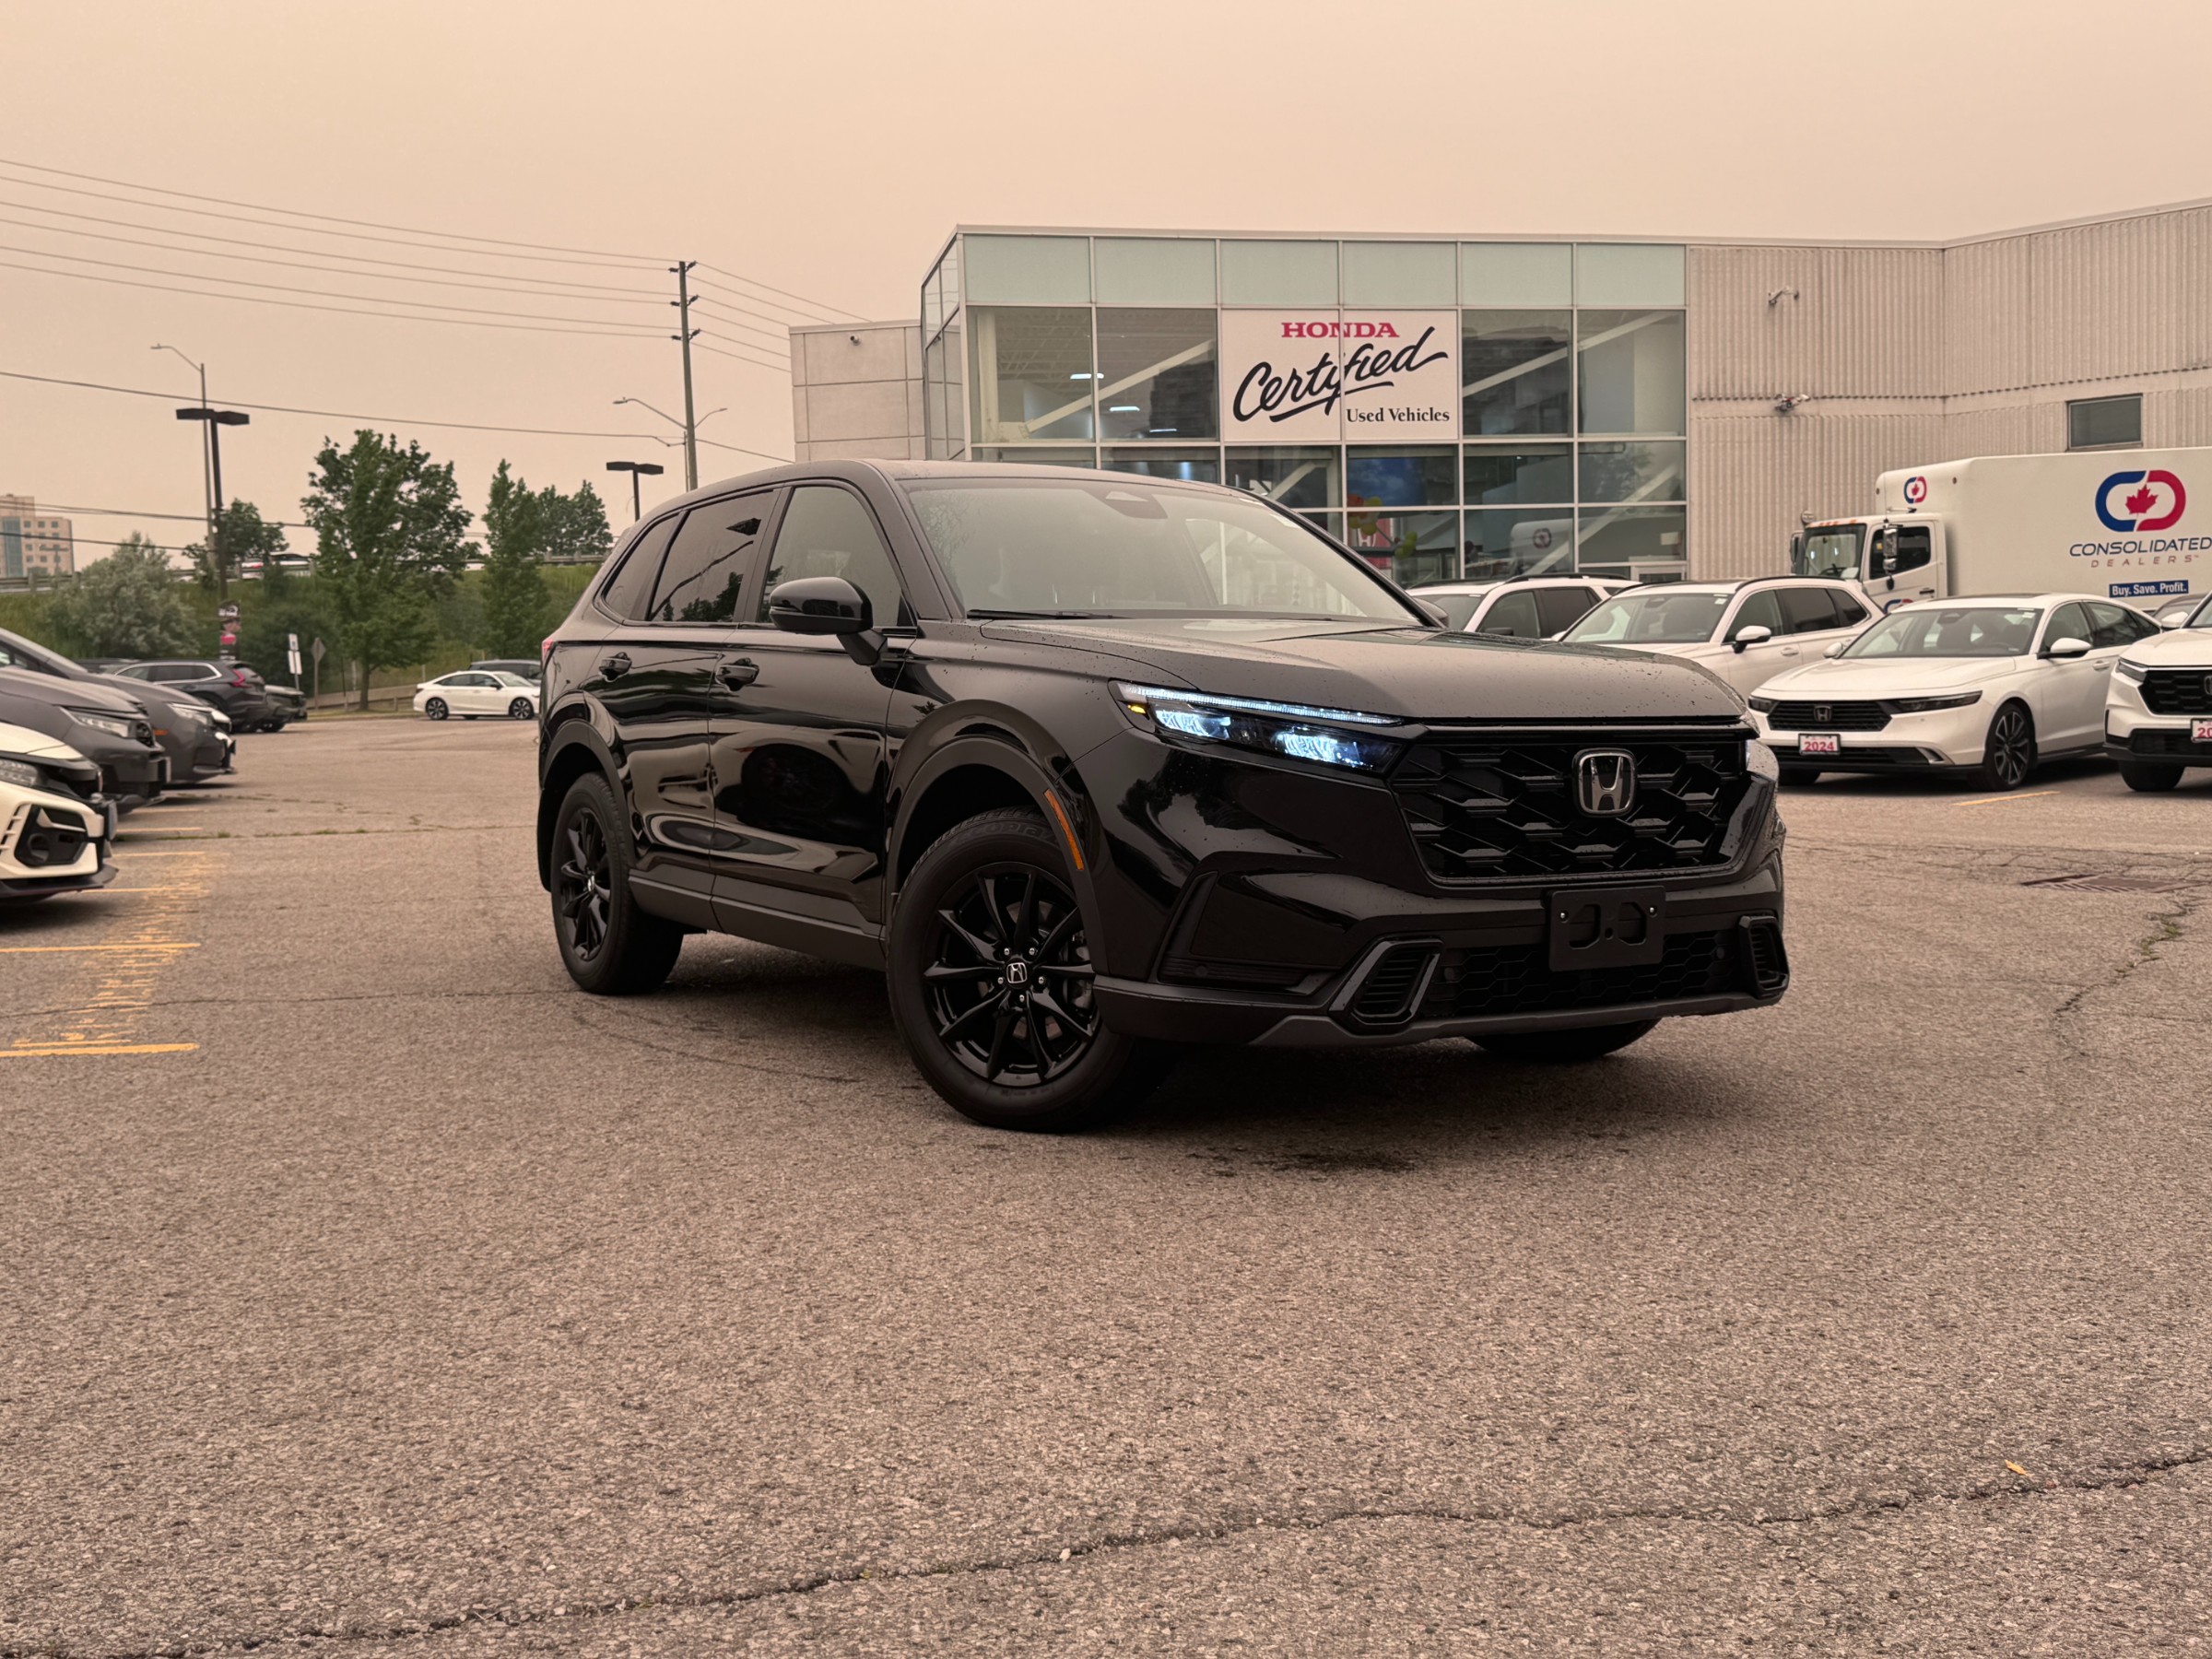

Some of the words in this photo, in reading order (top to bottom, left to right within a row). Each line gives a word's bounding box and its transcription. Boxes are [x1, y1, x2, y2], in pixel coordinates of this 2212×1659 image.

[1281, 322, 1400, 338] HONDA
[1232, 325, 1449, 423] Certified
[1346, 407, 1384, 423] Used
[1388, 406, 1451, 422] Vehicles
[2069, 536, 2212, 557] CONSOLIDATED
[2112, 585, 2132, 597] Buy.
[2133, 583, 2158, 595] Save.
[2159, 582, 2187, 594] Profit.
[1805, 741, 1834, 752] 2024
